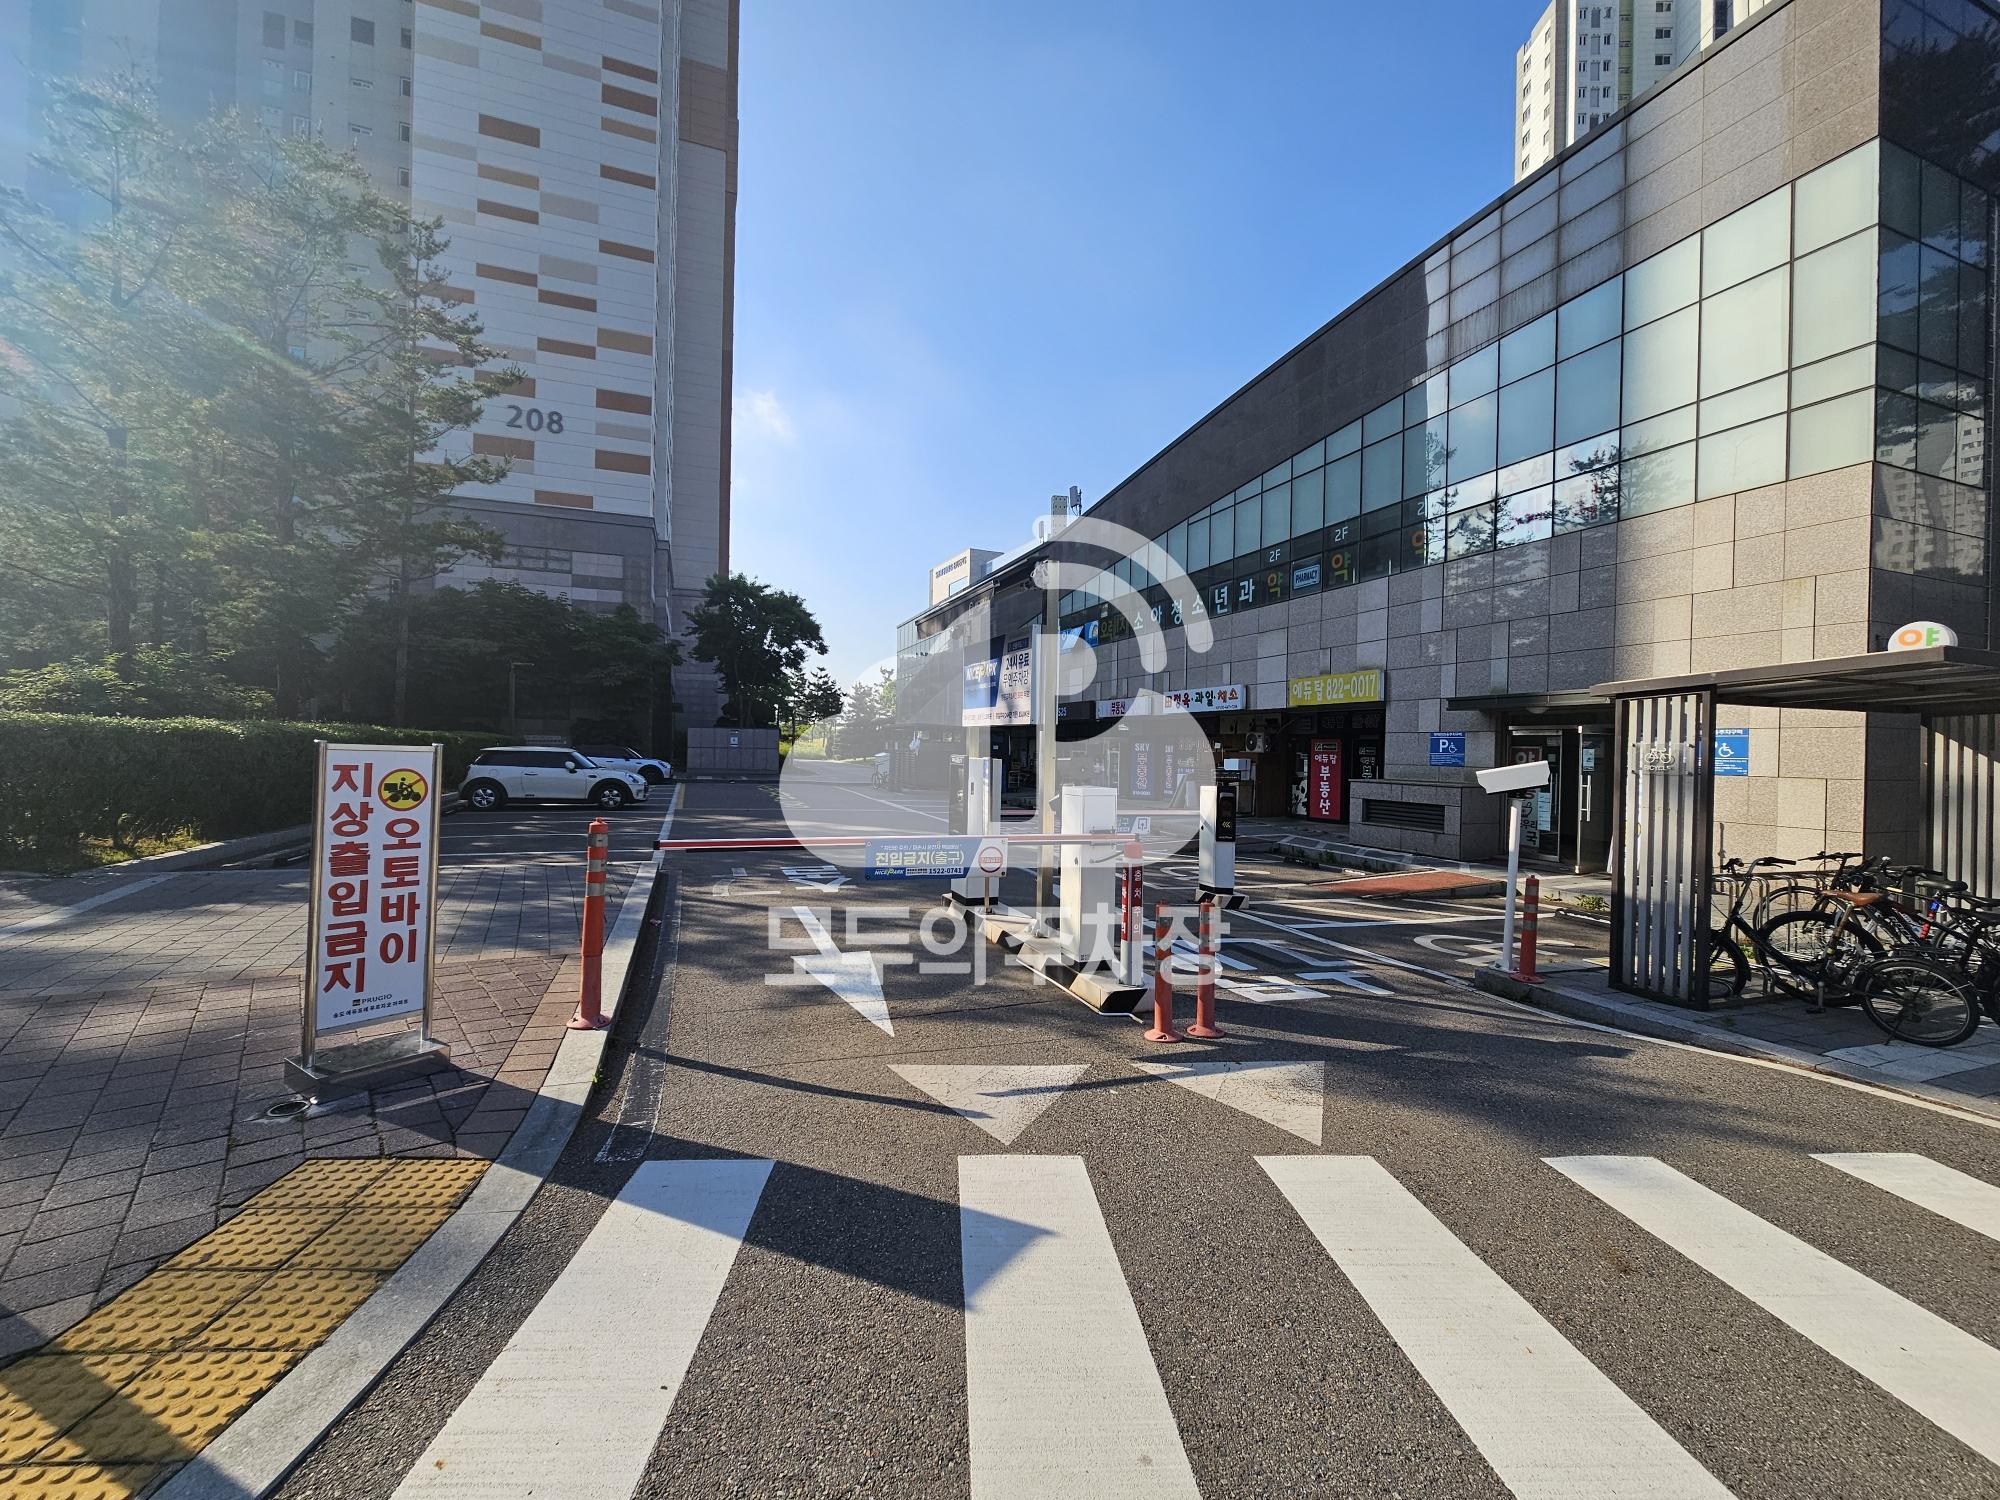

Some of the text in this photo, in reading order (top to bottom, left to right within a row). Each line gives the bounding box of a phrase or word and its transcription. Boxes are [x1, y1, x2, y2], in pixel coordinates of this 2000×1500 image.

[506, 404, 564, 434] 208
[1334, 526, 1349, 542] 2F
[1269, 549, 1281, 562] 2F
[1331, 551, 1351, 581] 약
[1267, 572, 1283, 597] 약
[1296, 569, 1318, 584] PHARMACY
[1293, 675, 1376, 701] 에듀탑 822-0017
[1111, 702, 1126, 715] 부동산
[1439, 739, 1449, 752] P
[1315, 754, 1337, 764] 에듀탑
[1320, 765, 1330, 815] 부동산
[875, 850, 964, 867] 진입금지(출구)
[929, 867, 963, 875] 1522-0741
[379, 818, 421, 964] 오토바이
[362, 994, 392, 1004] PRUGIO
